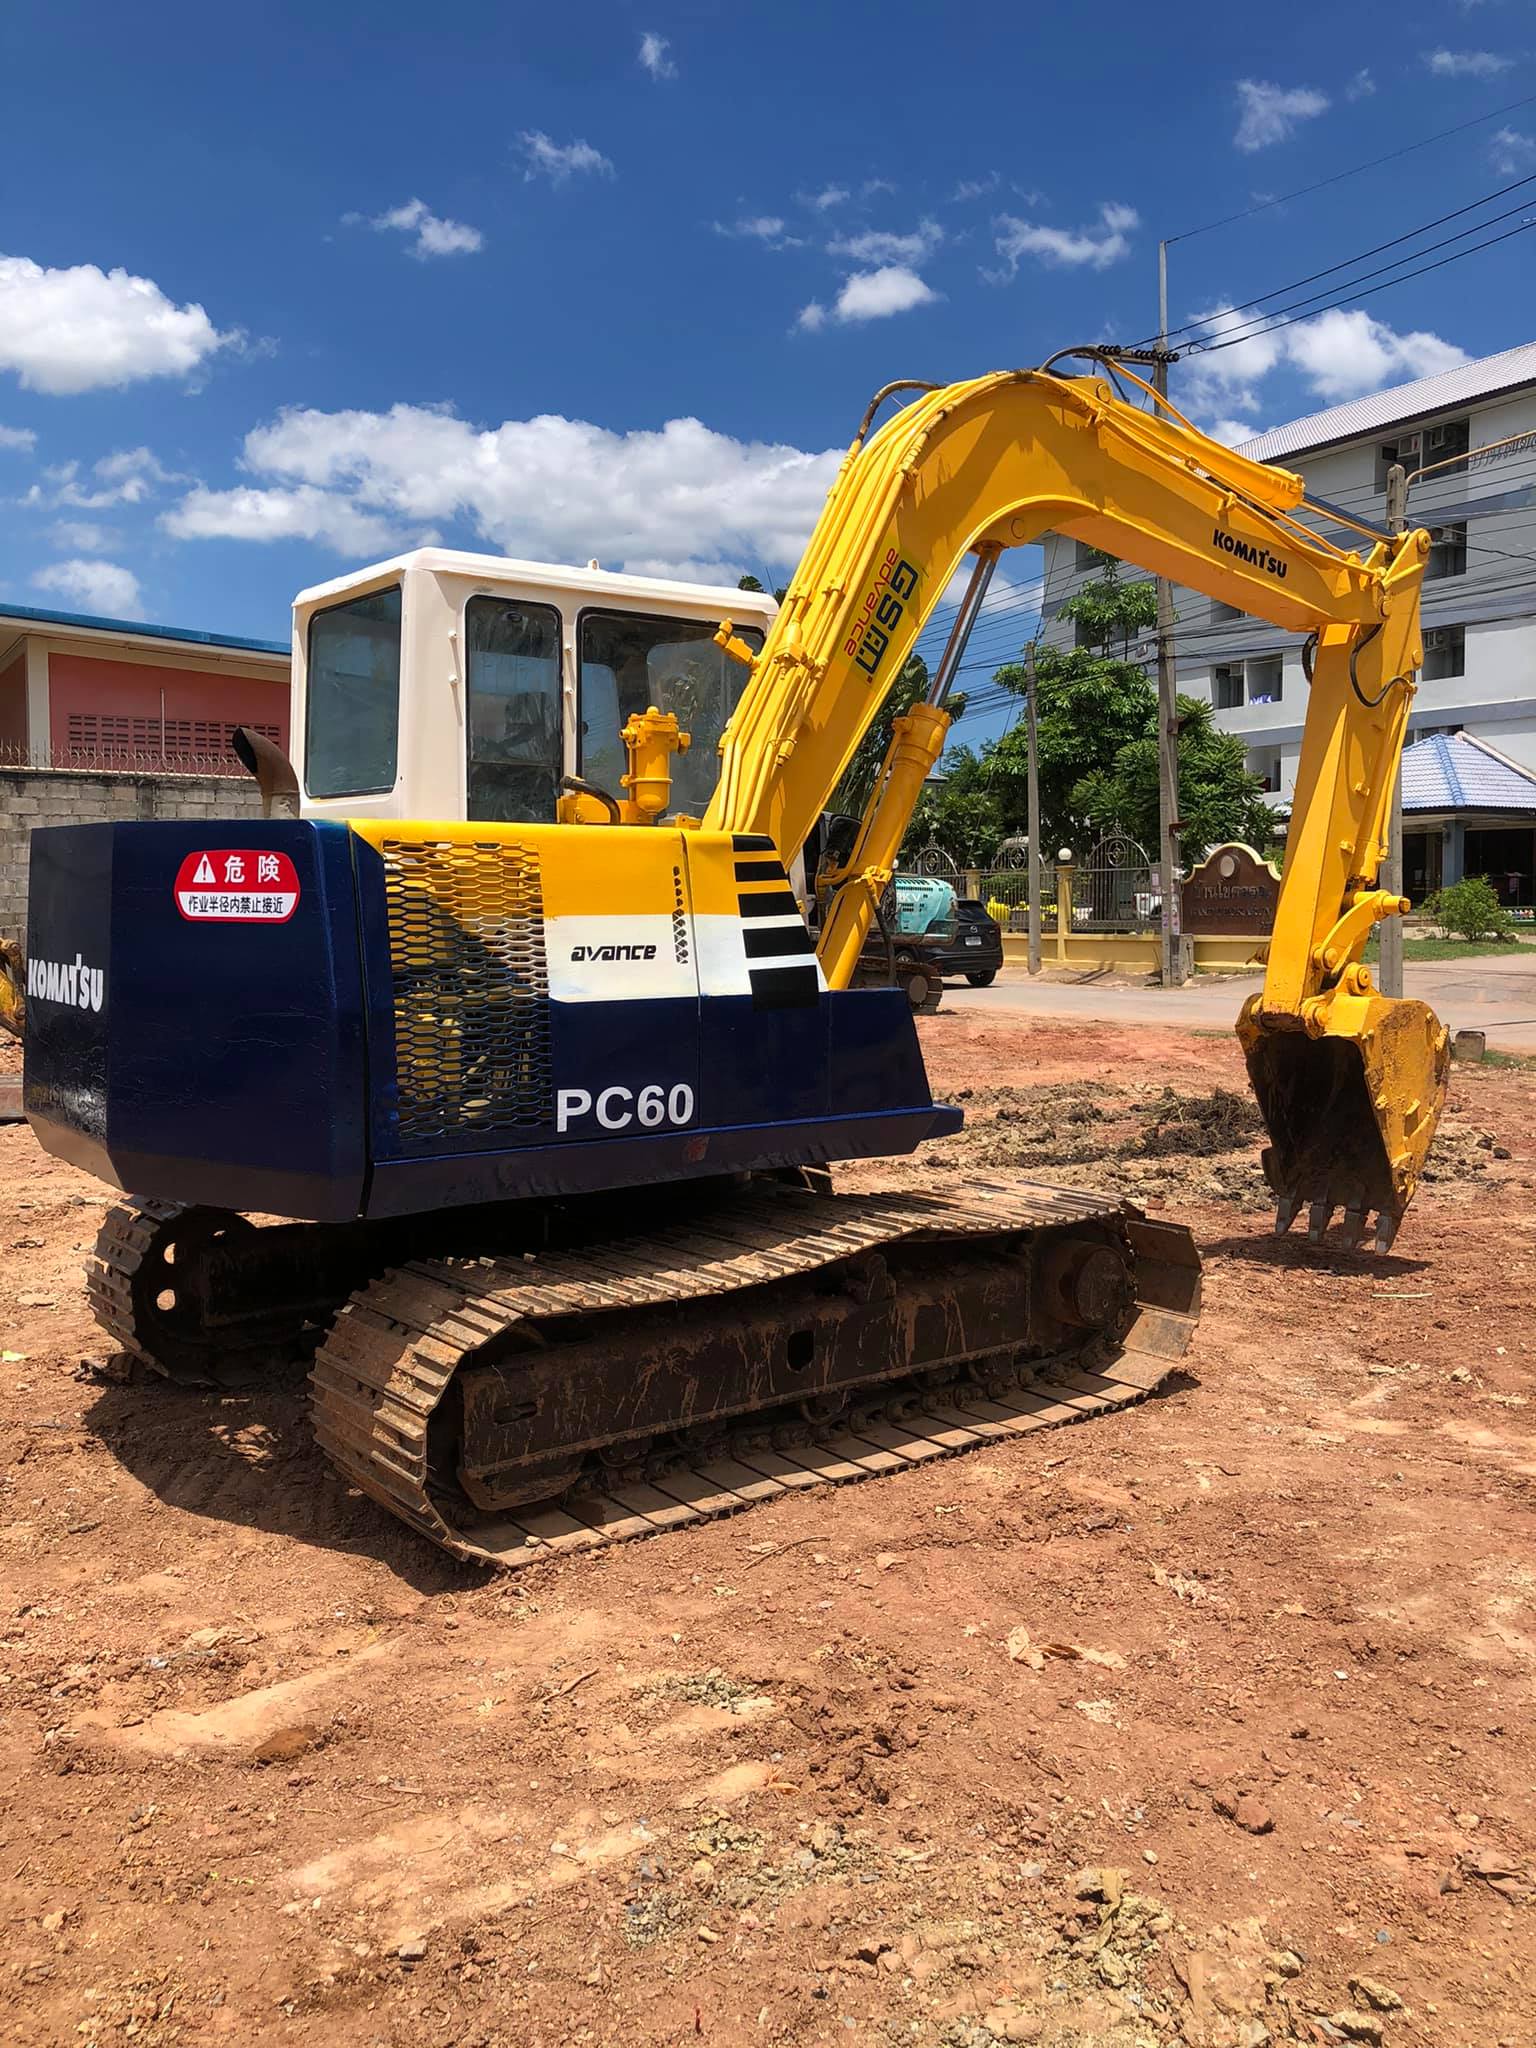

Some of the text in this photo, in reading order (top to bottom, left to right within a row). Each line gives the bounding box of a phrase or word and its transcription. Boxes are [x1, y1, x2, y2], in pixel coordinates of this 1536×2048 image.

[1213, 528, 1288, 578] KOMATSU
[844, 548, 899, 657] advance
[224, 854, 281, 883] 危険
[188, 896, 284, 914] 作业半径内禁止接近
[571, 945, 657, 962] avance
[27, 953, 104, 1013] KOMATSU
[557, 1083, 694, 1133] PC60
